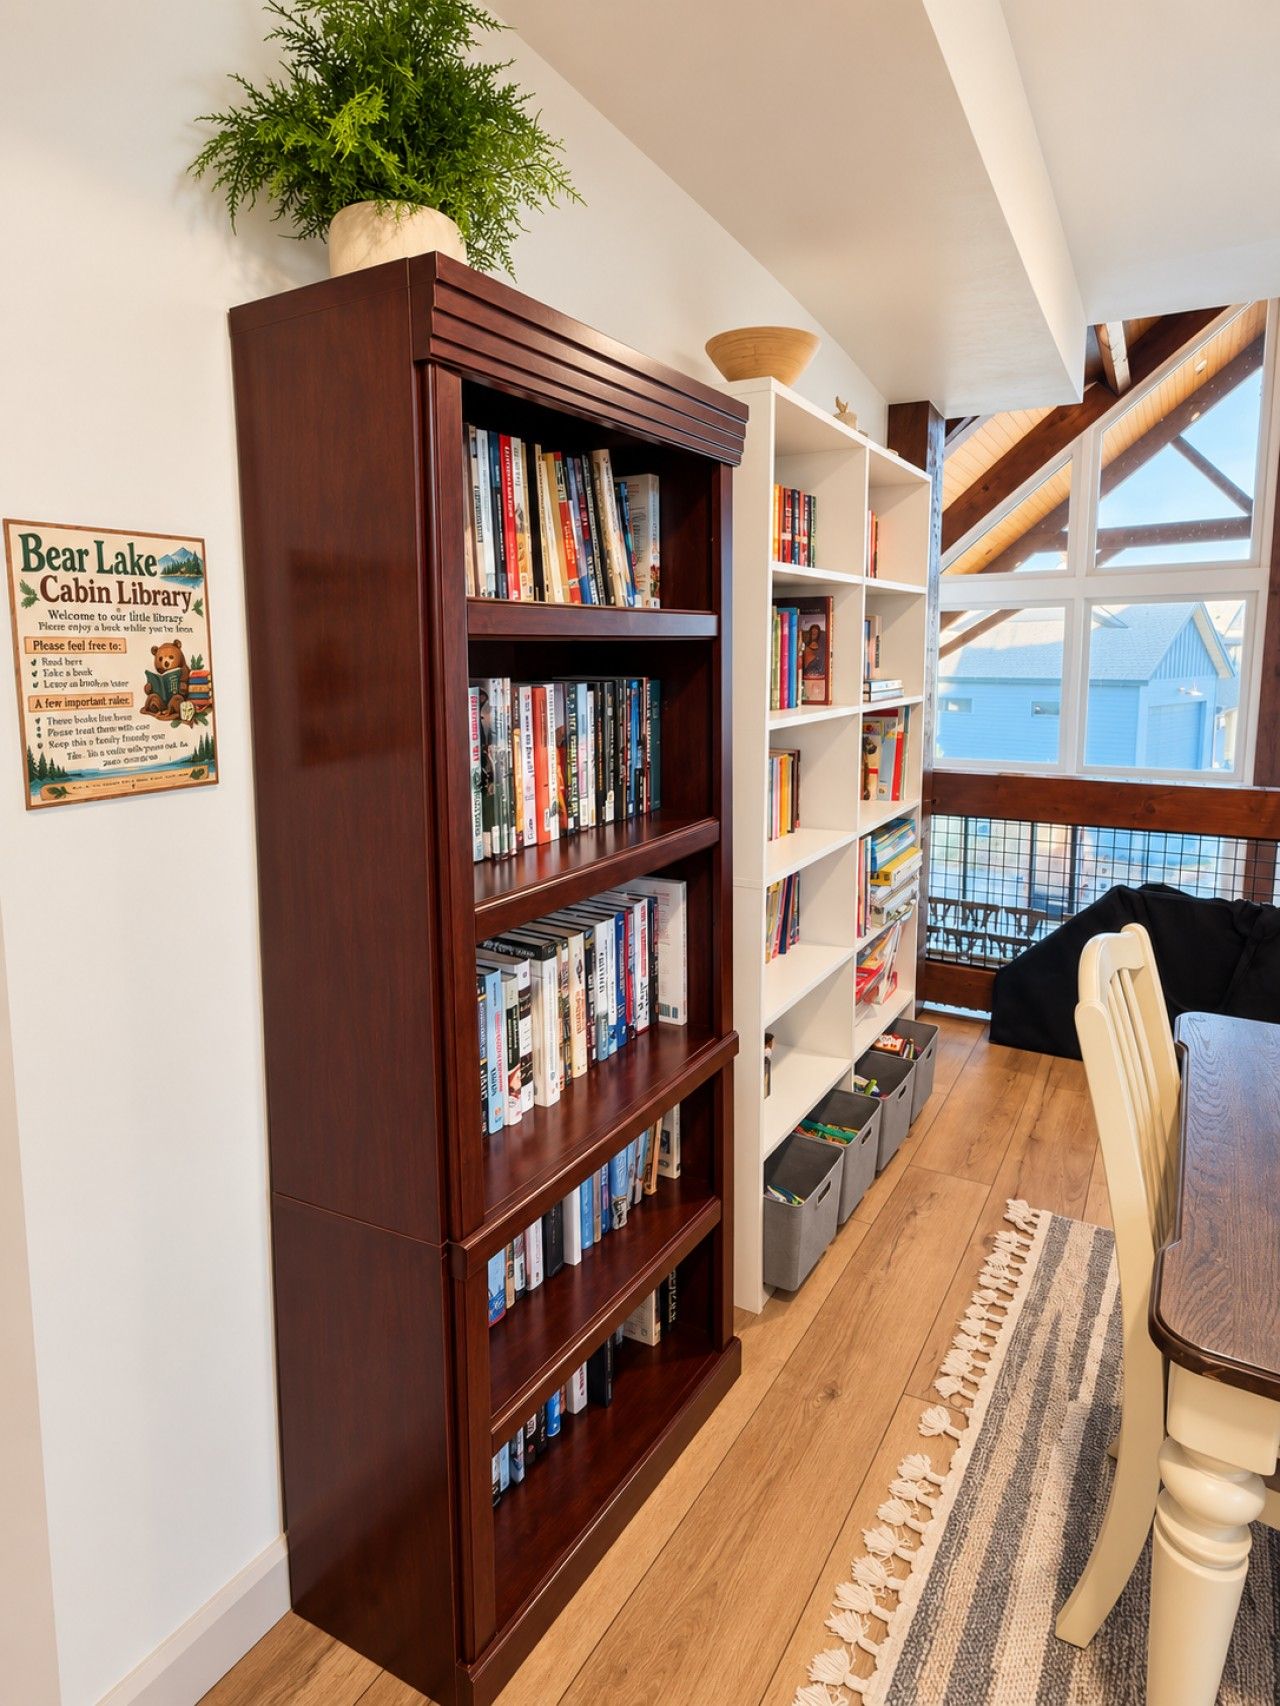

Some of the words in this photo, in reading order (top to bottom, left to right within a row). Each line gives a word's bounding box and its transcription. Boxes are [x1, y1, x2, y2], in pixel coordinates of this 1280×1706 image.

[18, 533, 90, 573] Bear
[93, 540, 158, 577] Lake
[39, 574, 113, 605] Cabin
[115, 580, 193, 614] Library
[47, 609, 95, 621] Welcome
[97, 612, 108, 621] to
[110, 613, 126, 622] our
[129, 610, 151, 622] little
[67, 622, 91, 634] enjoy
[32, 640, 66, 651] Please
[67, 640, 86, 651] feel
[88, 640, 107, 651] free
[108, 642, 122, 651] to:
[34, 698, 43, 709] A
[44, 698, 64, 709] few
[64, 696, 107, 710] important
